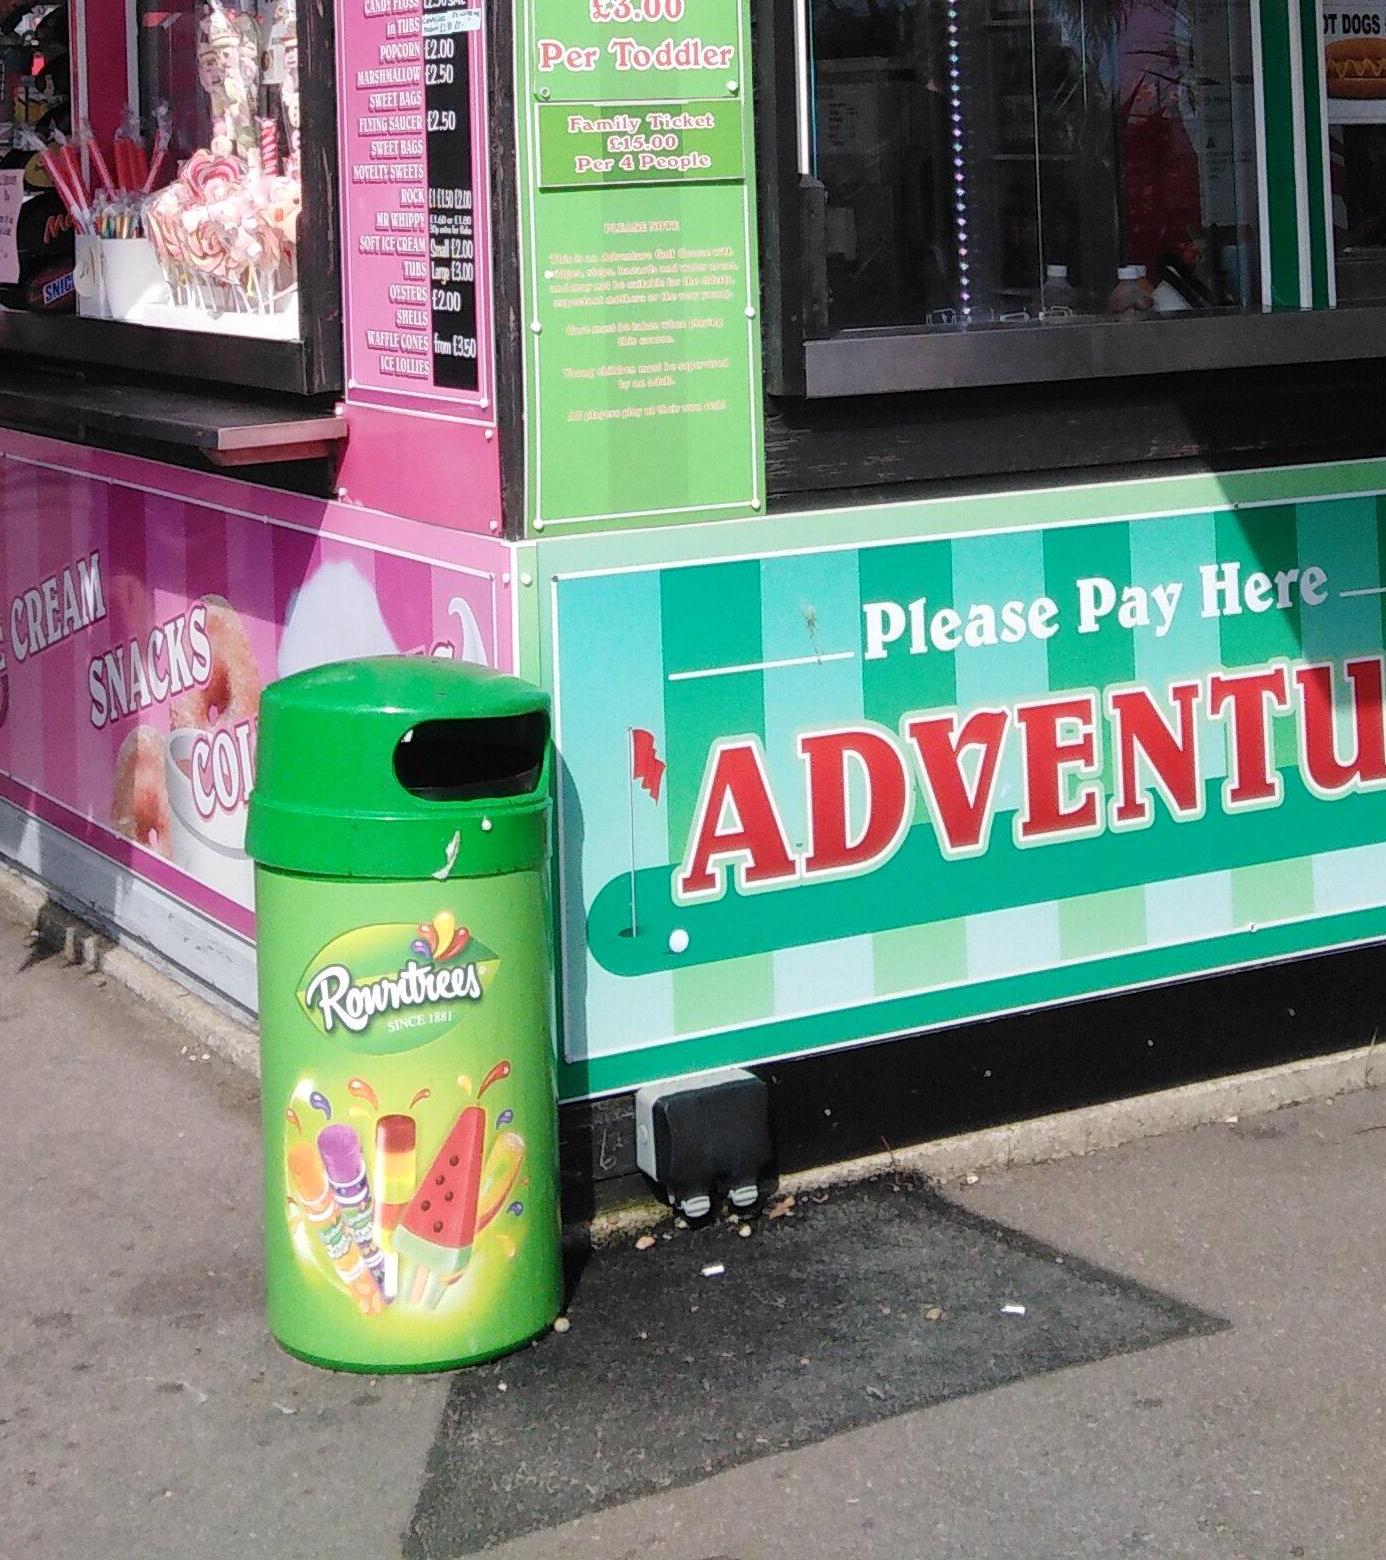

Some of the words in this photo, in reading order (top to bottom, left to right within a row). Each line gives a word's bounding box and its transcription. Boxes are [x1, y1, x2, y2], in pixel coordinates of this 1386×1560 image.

[387, 23, 395, 35] in
[397, 17, 420, 33] TUBS
[1341, 14, 1381, 35] DOGS
[379, 42, 420, 60] POPCORN
[425, 38, 454, 59] £2.00
[539, 42, 598, 69] Per
[610, 40, 733, 69] Toddler
[356, 66, 421, 86] MARSHMALLOW
[425, 64, 453, 85] £2.50
[370, 92, 398, 108] SWEET
[400, 90, 422, 107] BAGS
[359, 117, 387, 132] FLYING
[389, 115, 423, 131] SAUCER
[427, 110, 456, 131] £2.50
[568, 116, 640, 133] Family
[647, 113, 714, 130] Ticket
[371, 141, 399, 156] SWEET
[400, 139, 423, 155] BAGS
[608, 135, 679, 152] £15.00
[353, 165, 388, 180] NOVELTY
[390, 163, 424, 179] SWEETS
[576, 157, 613, 172] Per
[619, 155, 634, 170] 4
[640, 153, 711, 171] People
[400, 187, 424, 204] ROCK
[376, 212, 389, 228] MR
[391, 212, 425, 228] WHIPPY
[359, 237, 380, 252] SOFT
[382, 236, 395, 250] ICE
[396, 236, 426, 252] CREAM
[430, 238, 450, 257] Small
[451, 238, 473, 258] £2.00
[403, 261, 427, 277] TUBS
[432, 261, 450, 285] Large
[451, 261, 473, 281] £3.00
[44, 272, 76, 301] SNIC
[389, 285, 428, 301] OYSTERS
[432, 290, 461, 311] £2.00
[396, 309, 429, 326] SHELLS
[367, 330, 400, 348] WAFFLE
[400, 333, 429, 351] CONES
[434, 333, 451, 354] from
[452, 334, 477, 358] £3.50
[380, 356, 395, 371] ICE
[396, 358, 429, 376] LOLLIES
[10, 549, 106, 663] CREAM
[864, 596, 1059, 660] Please
[1077, 576, 1183, 638] Pay
[1199, 561, 1328, 618] Here
[88, 604, 212, 730] SNACKS
[191, 716, 258, 818] COL
[387, 1013, 426, 1033] SINCE
[428, 1010, 454, 1026] 1881
